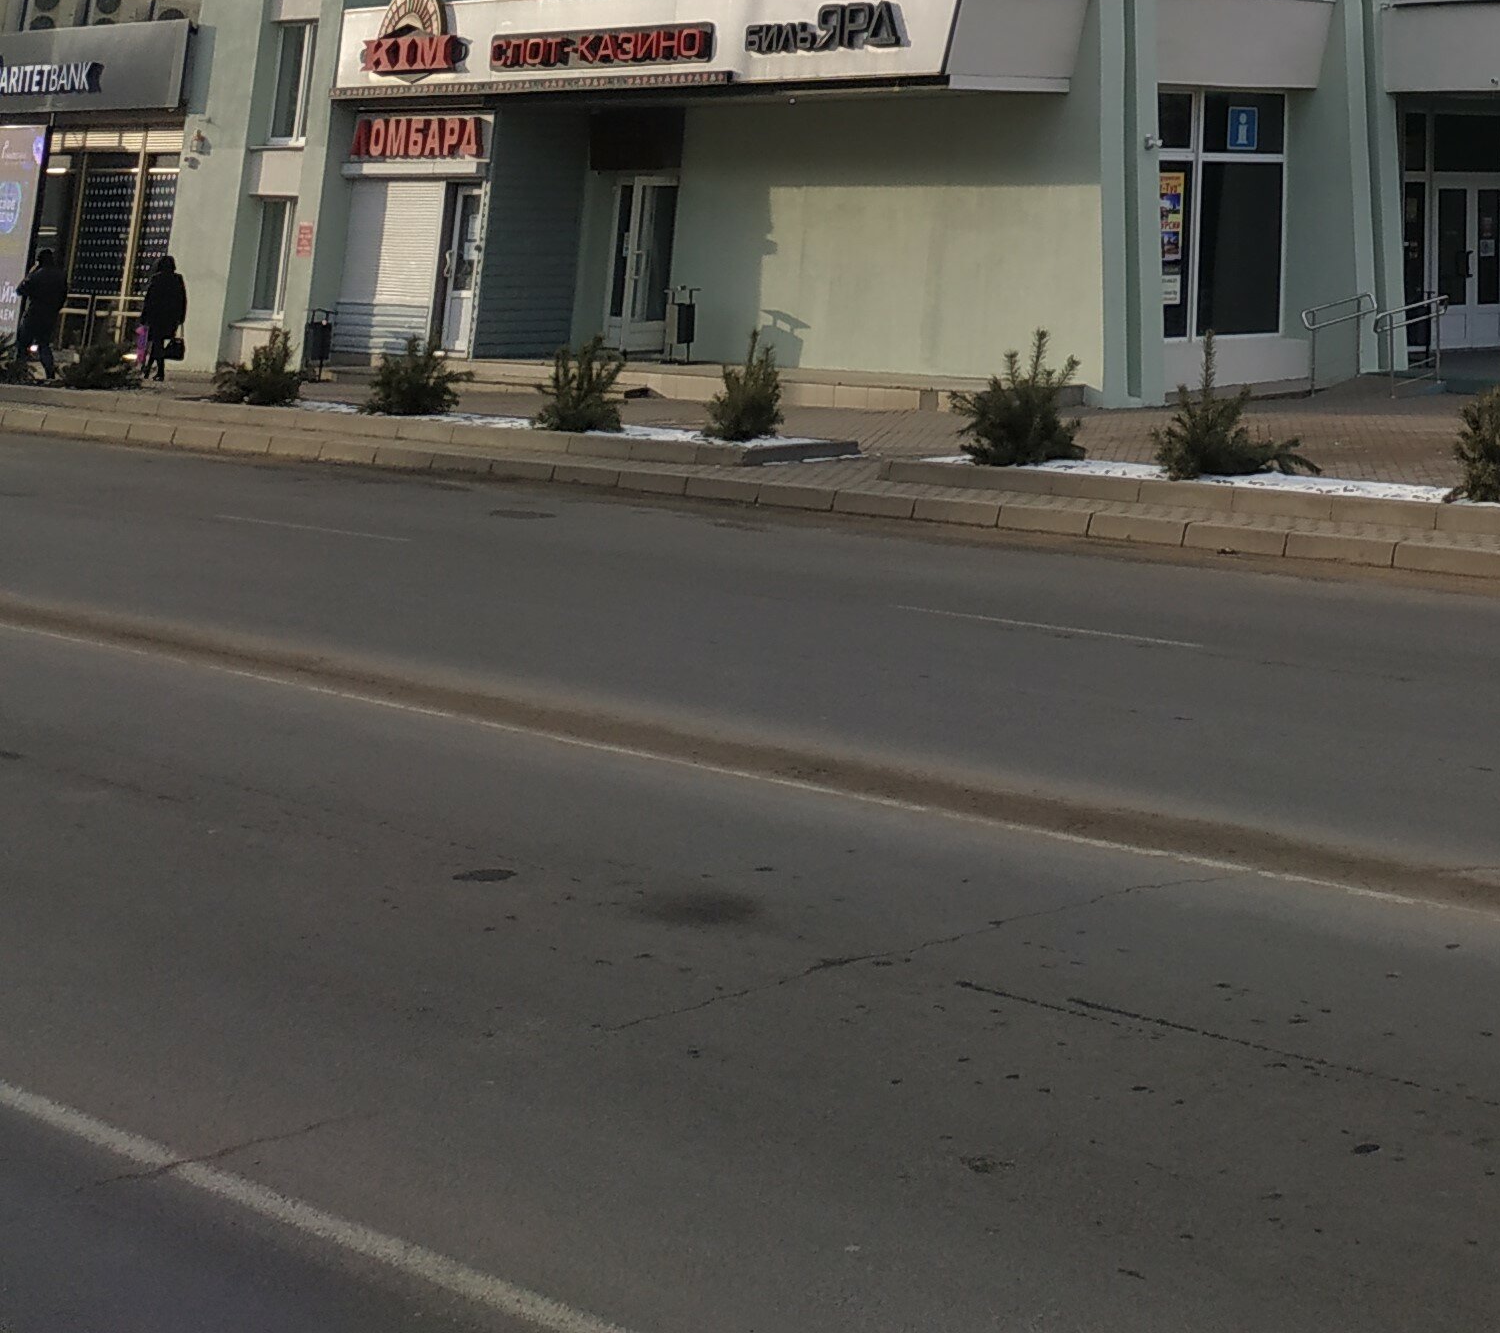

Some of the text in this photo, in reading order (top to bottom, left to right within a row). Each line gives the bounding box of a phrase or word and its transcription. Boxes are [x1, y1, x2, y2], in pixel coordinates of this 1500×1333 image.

[490, 27, 704, 67] СЛОТ-КАЗИНО
[0, 60, 92, 94] ARITETBANK
[351, 117, 483, 158] ЛОМБАРД
